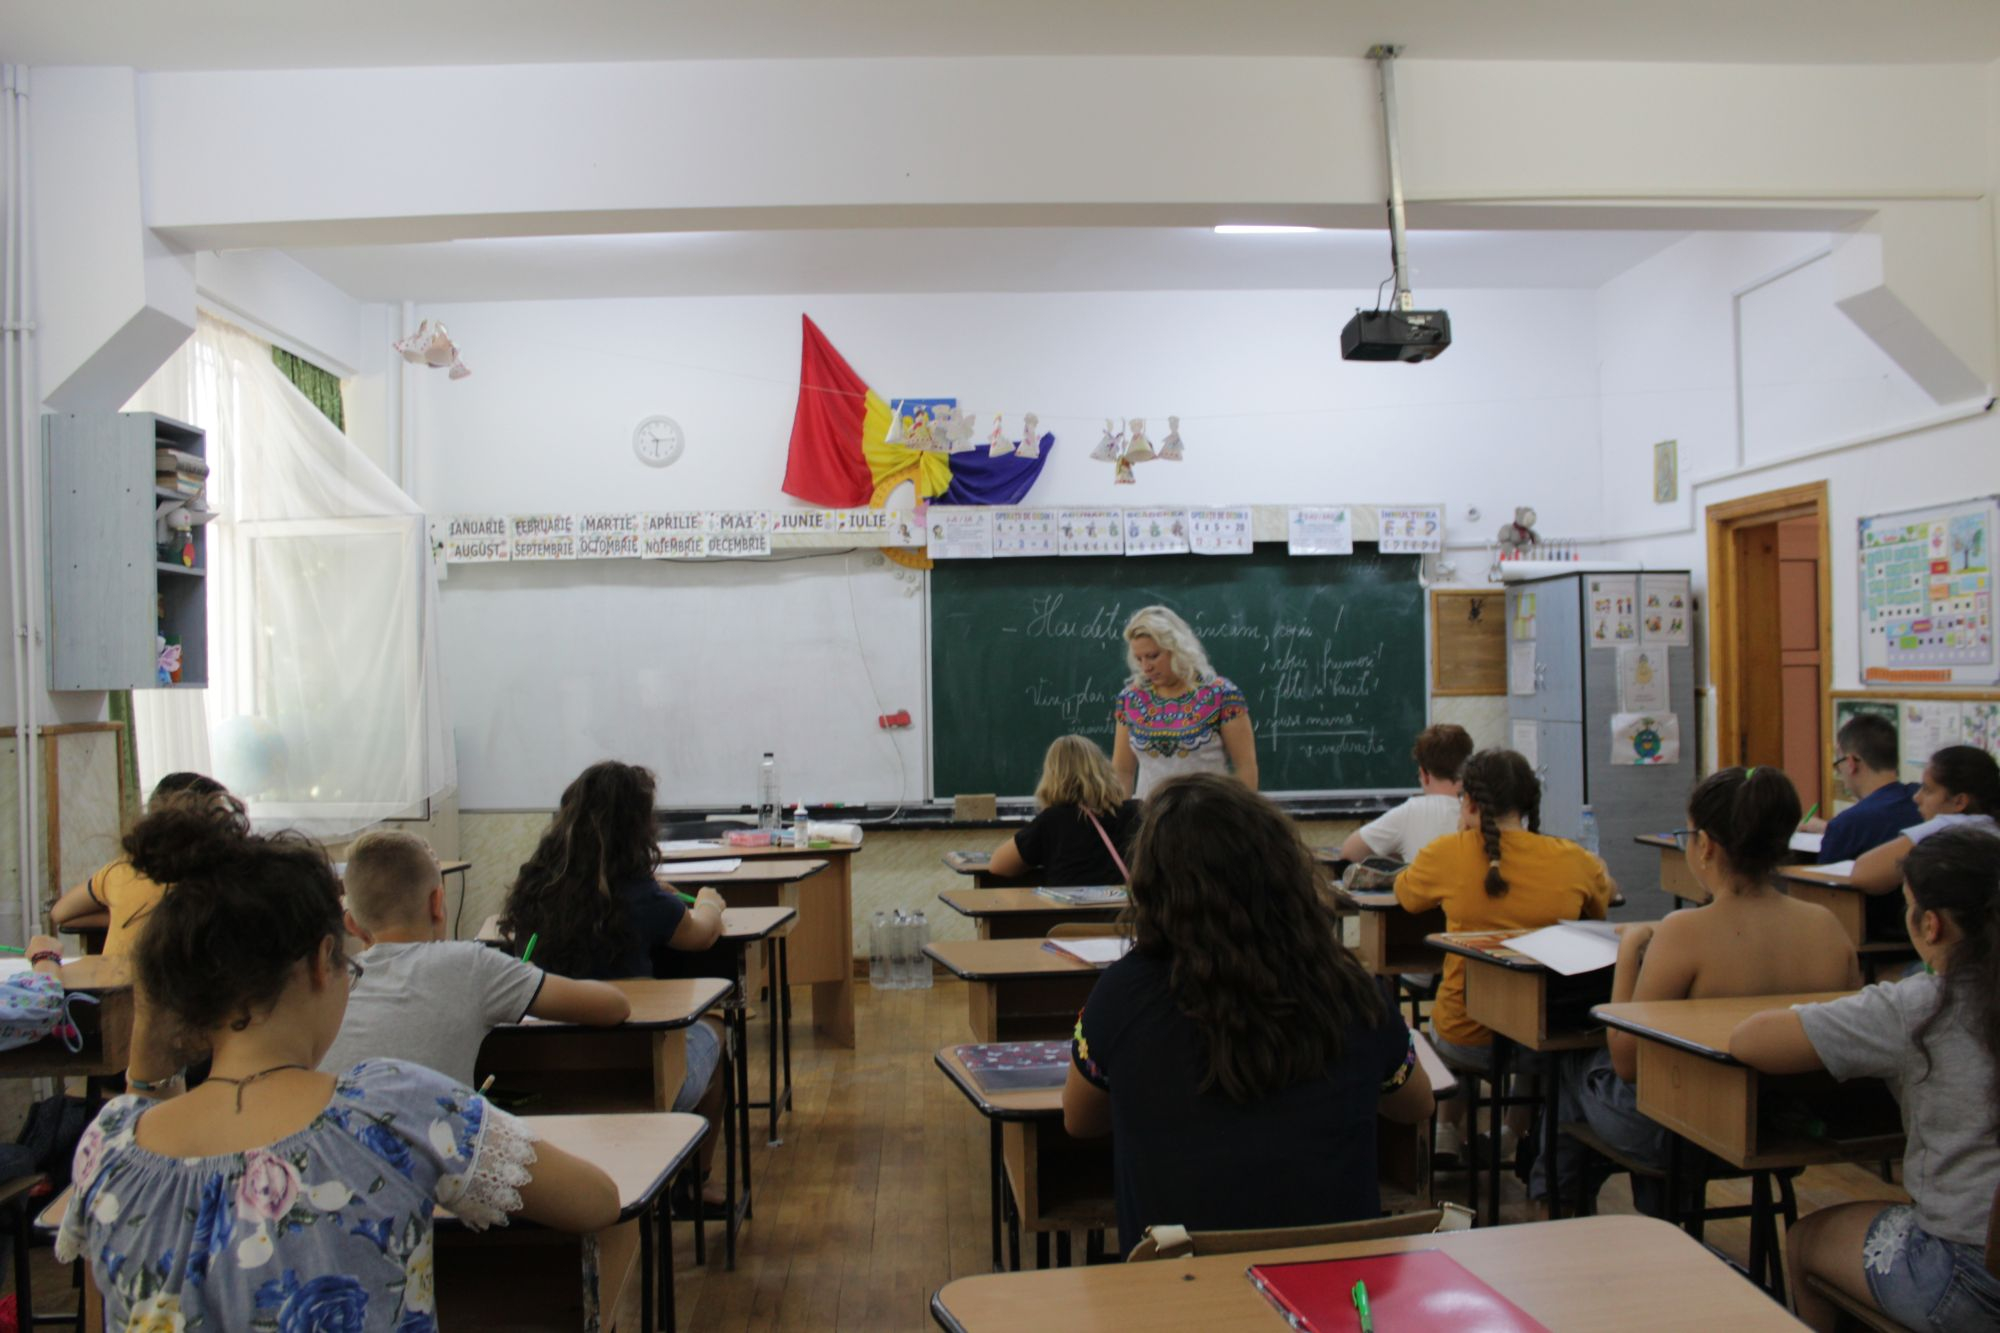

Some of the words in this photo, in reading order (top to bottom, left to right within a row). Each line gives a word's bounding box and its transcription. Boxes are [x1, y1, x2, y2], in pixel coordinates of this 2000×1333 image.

[450, 518, 505, 535] IANUARIE
[515, 516, 572, 534] FEBRUARIE
[586, 517, 633, 531] MARTIE
[650, 515, 698, 530] APRILIE
[721, 516, 753, 529] MAI
[782, 514, 823, 527] IUNIE
[850, 514, 886, 527] IULIE
[455, 543, 500, 557] AUGUST
[514, 542, 573, 556] SEPTEMBRIE
[581, 539, 638, 554] OCTOMBRIE
[708, 537, 766, 552] DECEMBRIE
